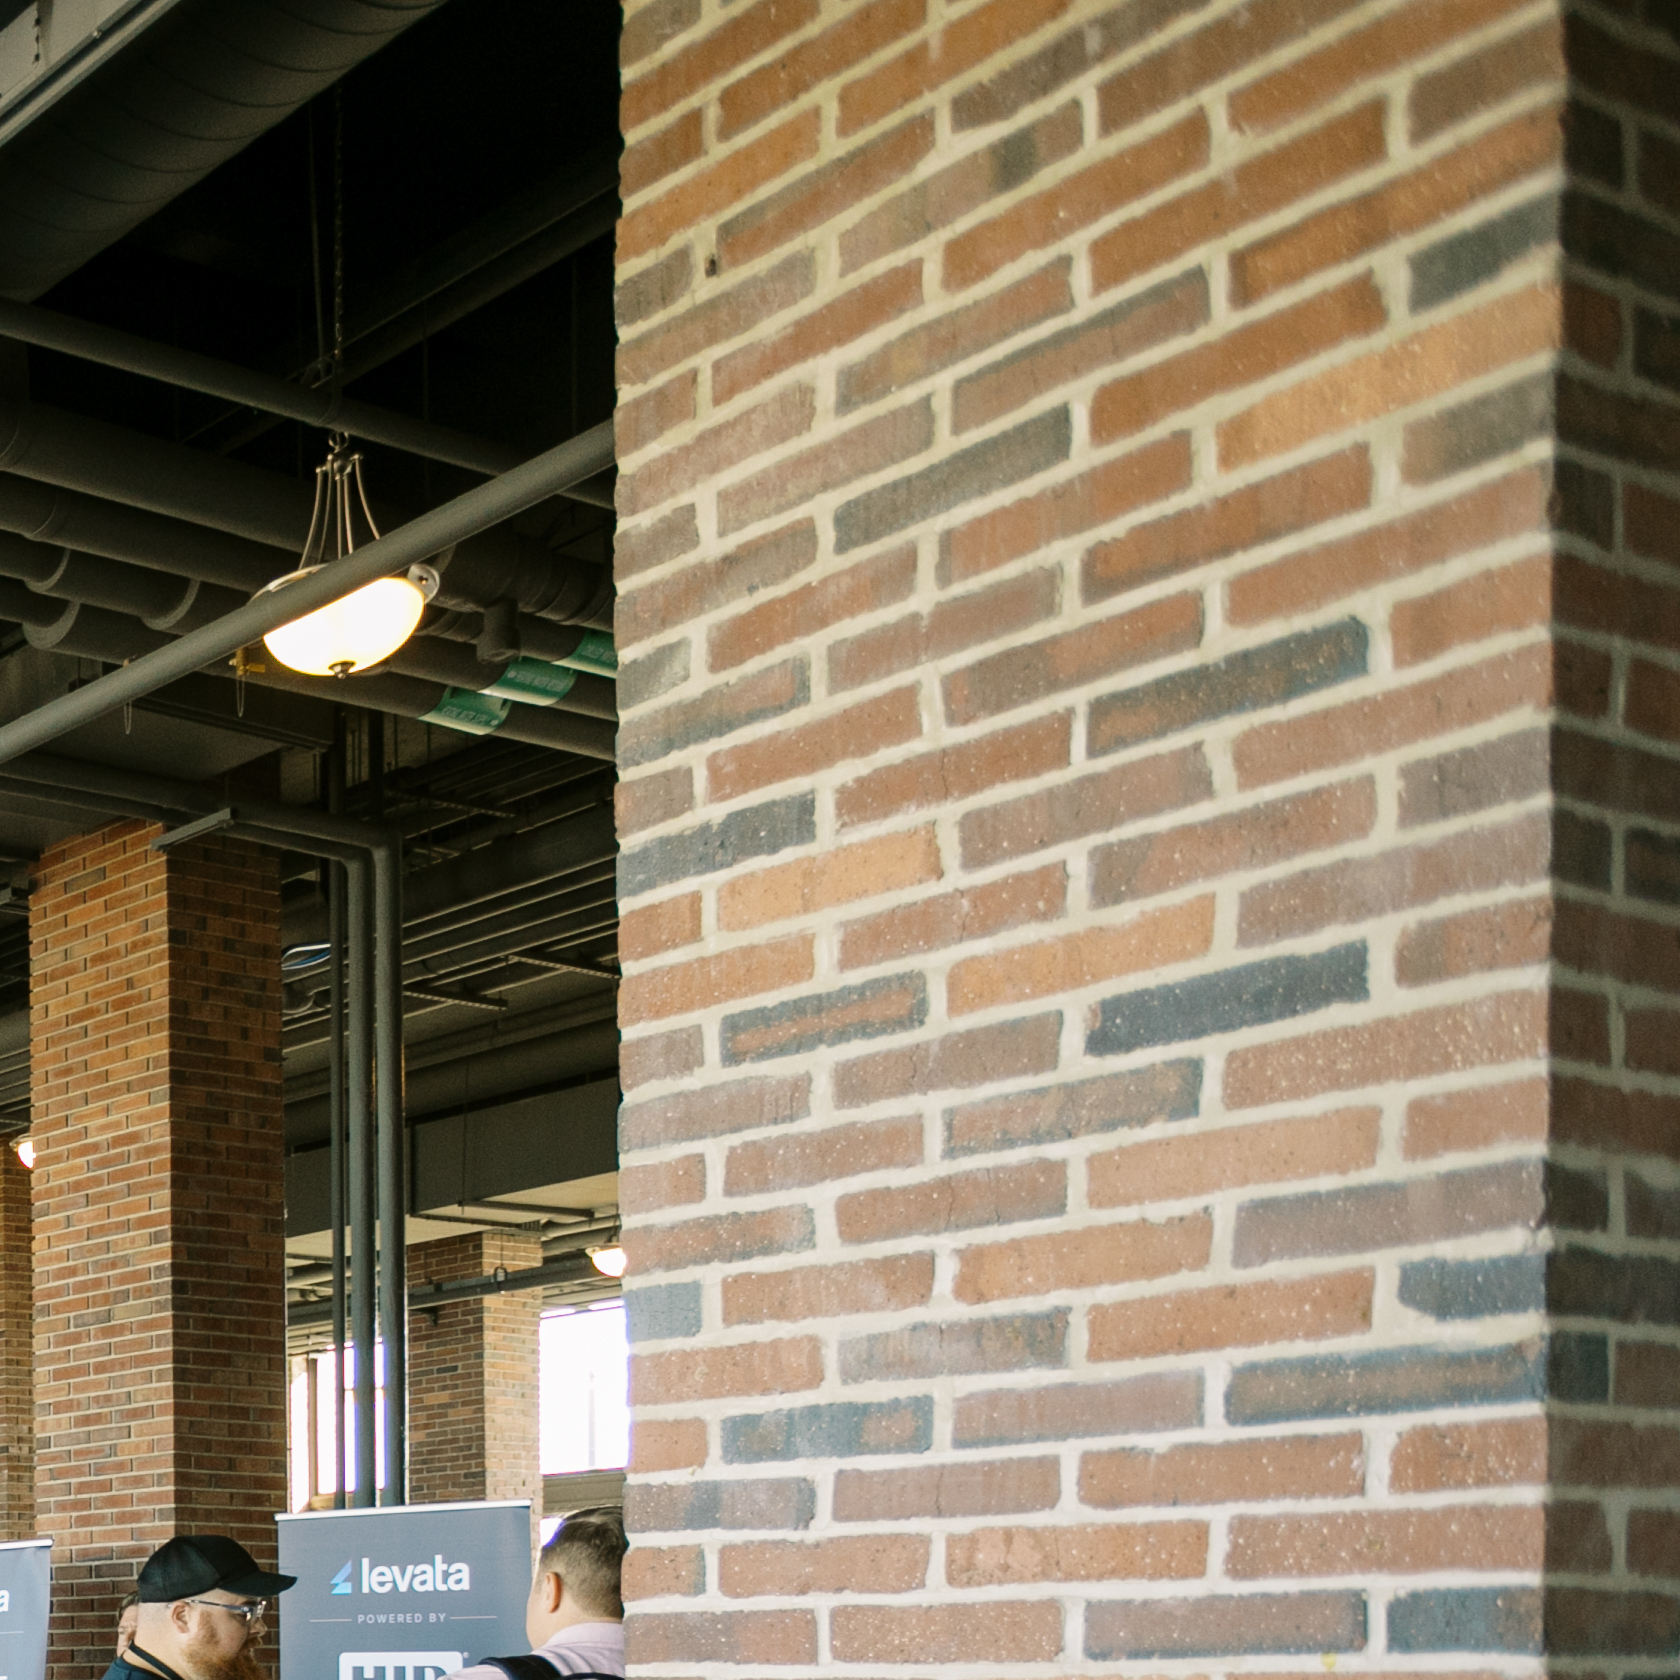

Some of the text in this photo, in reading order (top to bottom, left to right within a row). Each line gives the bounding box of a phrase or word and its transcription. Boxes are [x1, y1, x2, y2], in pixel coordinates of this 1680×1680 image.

[361, 1554, 470, 1594] levata
[357, 1612, 447, 1624] POWERED BY
